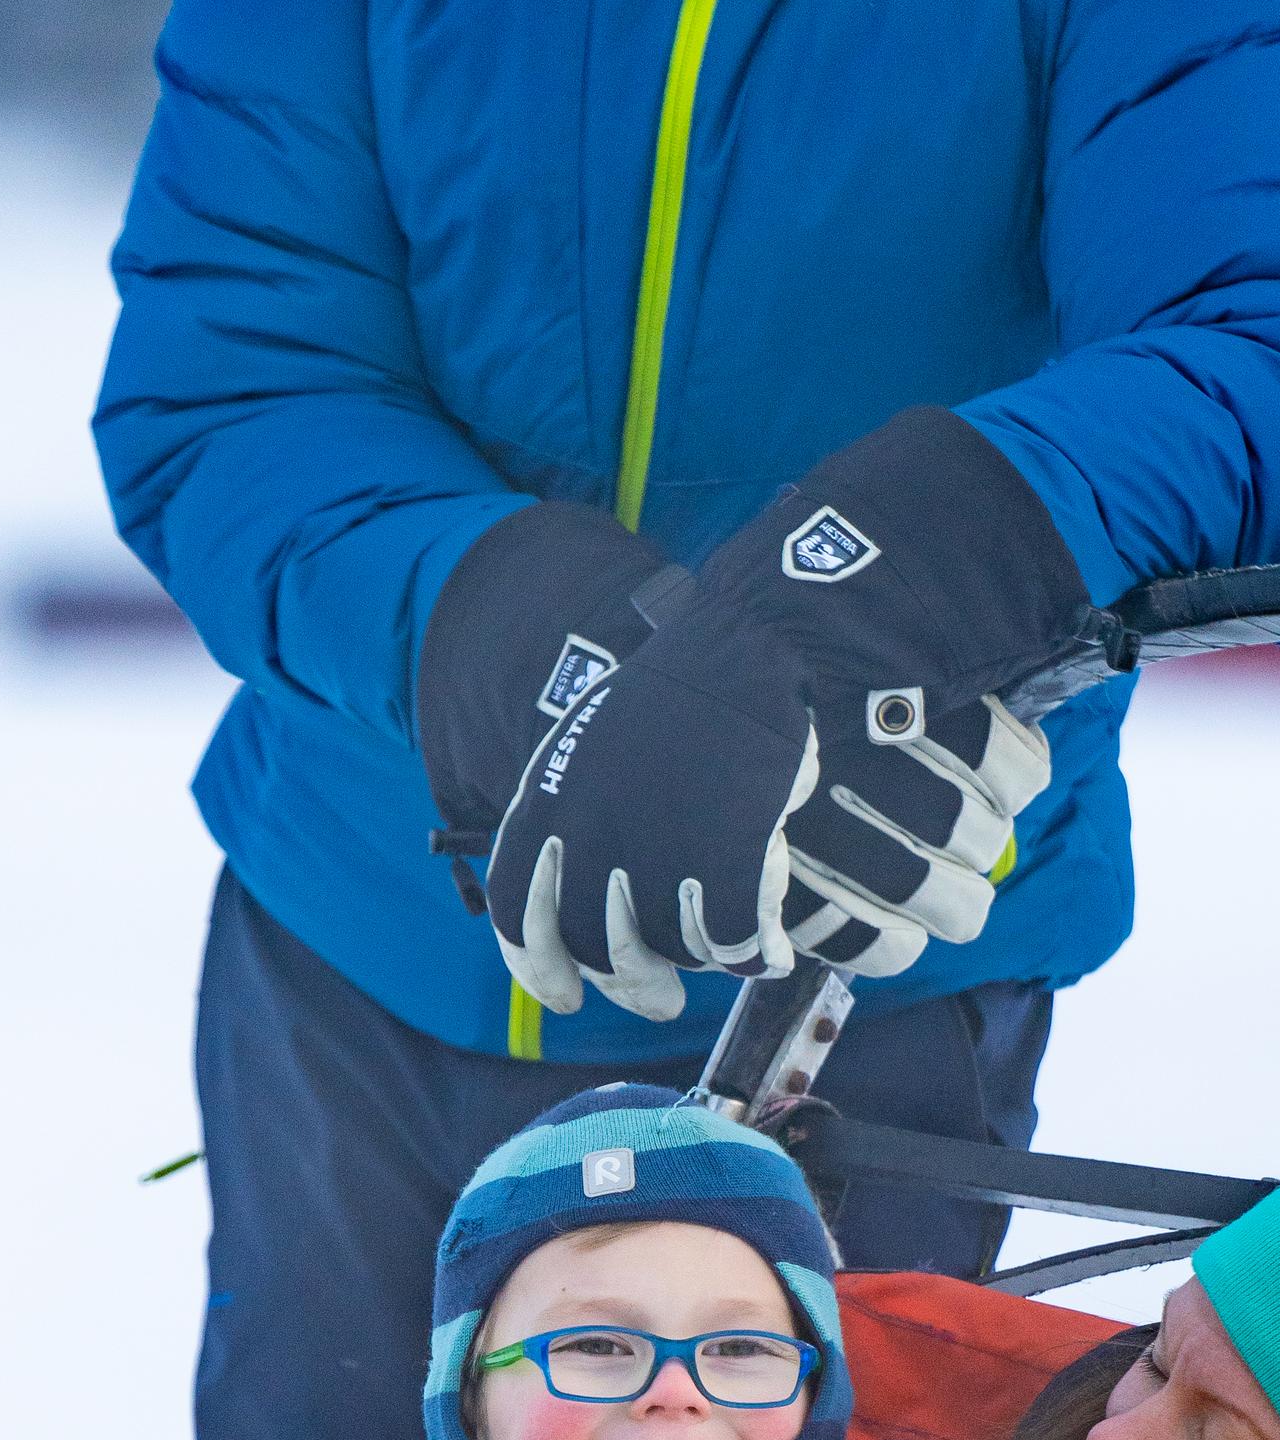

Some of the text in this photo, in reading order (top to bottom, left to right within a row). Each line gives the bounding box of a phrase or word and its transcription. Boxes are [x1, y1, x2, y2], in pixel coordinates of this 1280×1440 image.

[819, 521, 858, 556] HESTRA
[550, 654, 581, 702] HESTRA
[595, 1156, 621, 1186] R
